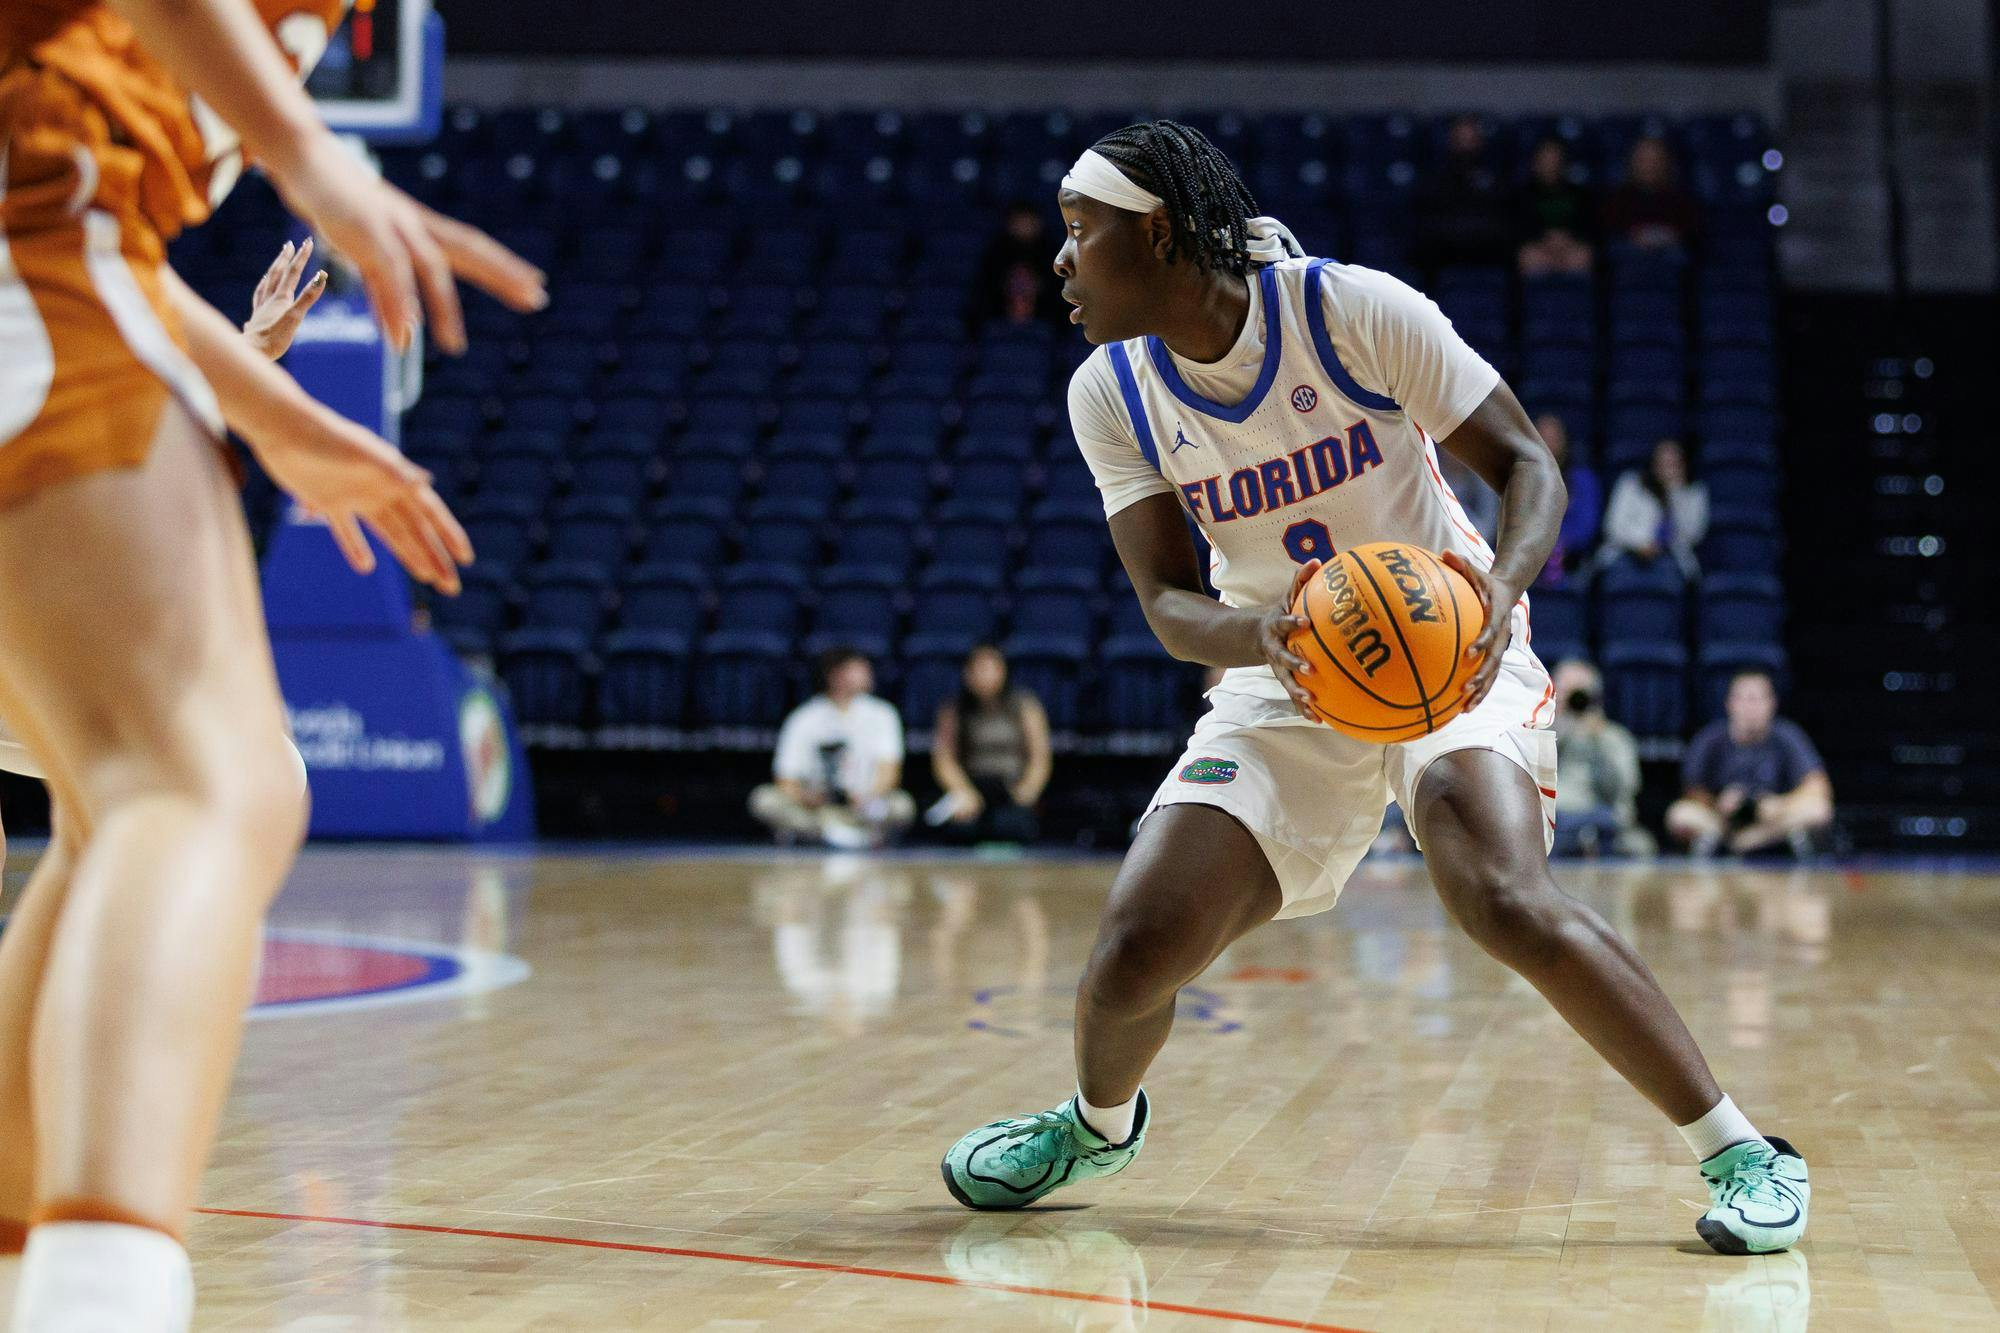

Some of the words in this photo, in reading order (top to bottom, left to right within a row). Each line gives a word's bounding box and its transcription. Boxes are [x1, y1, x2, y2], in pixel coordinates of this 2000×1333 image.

[1292, 386, 1316, 411] SEC
[1178, 418, 1384, 524] FLORIDA
[1376, 549, 1440, 624] NCAA
